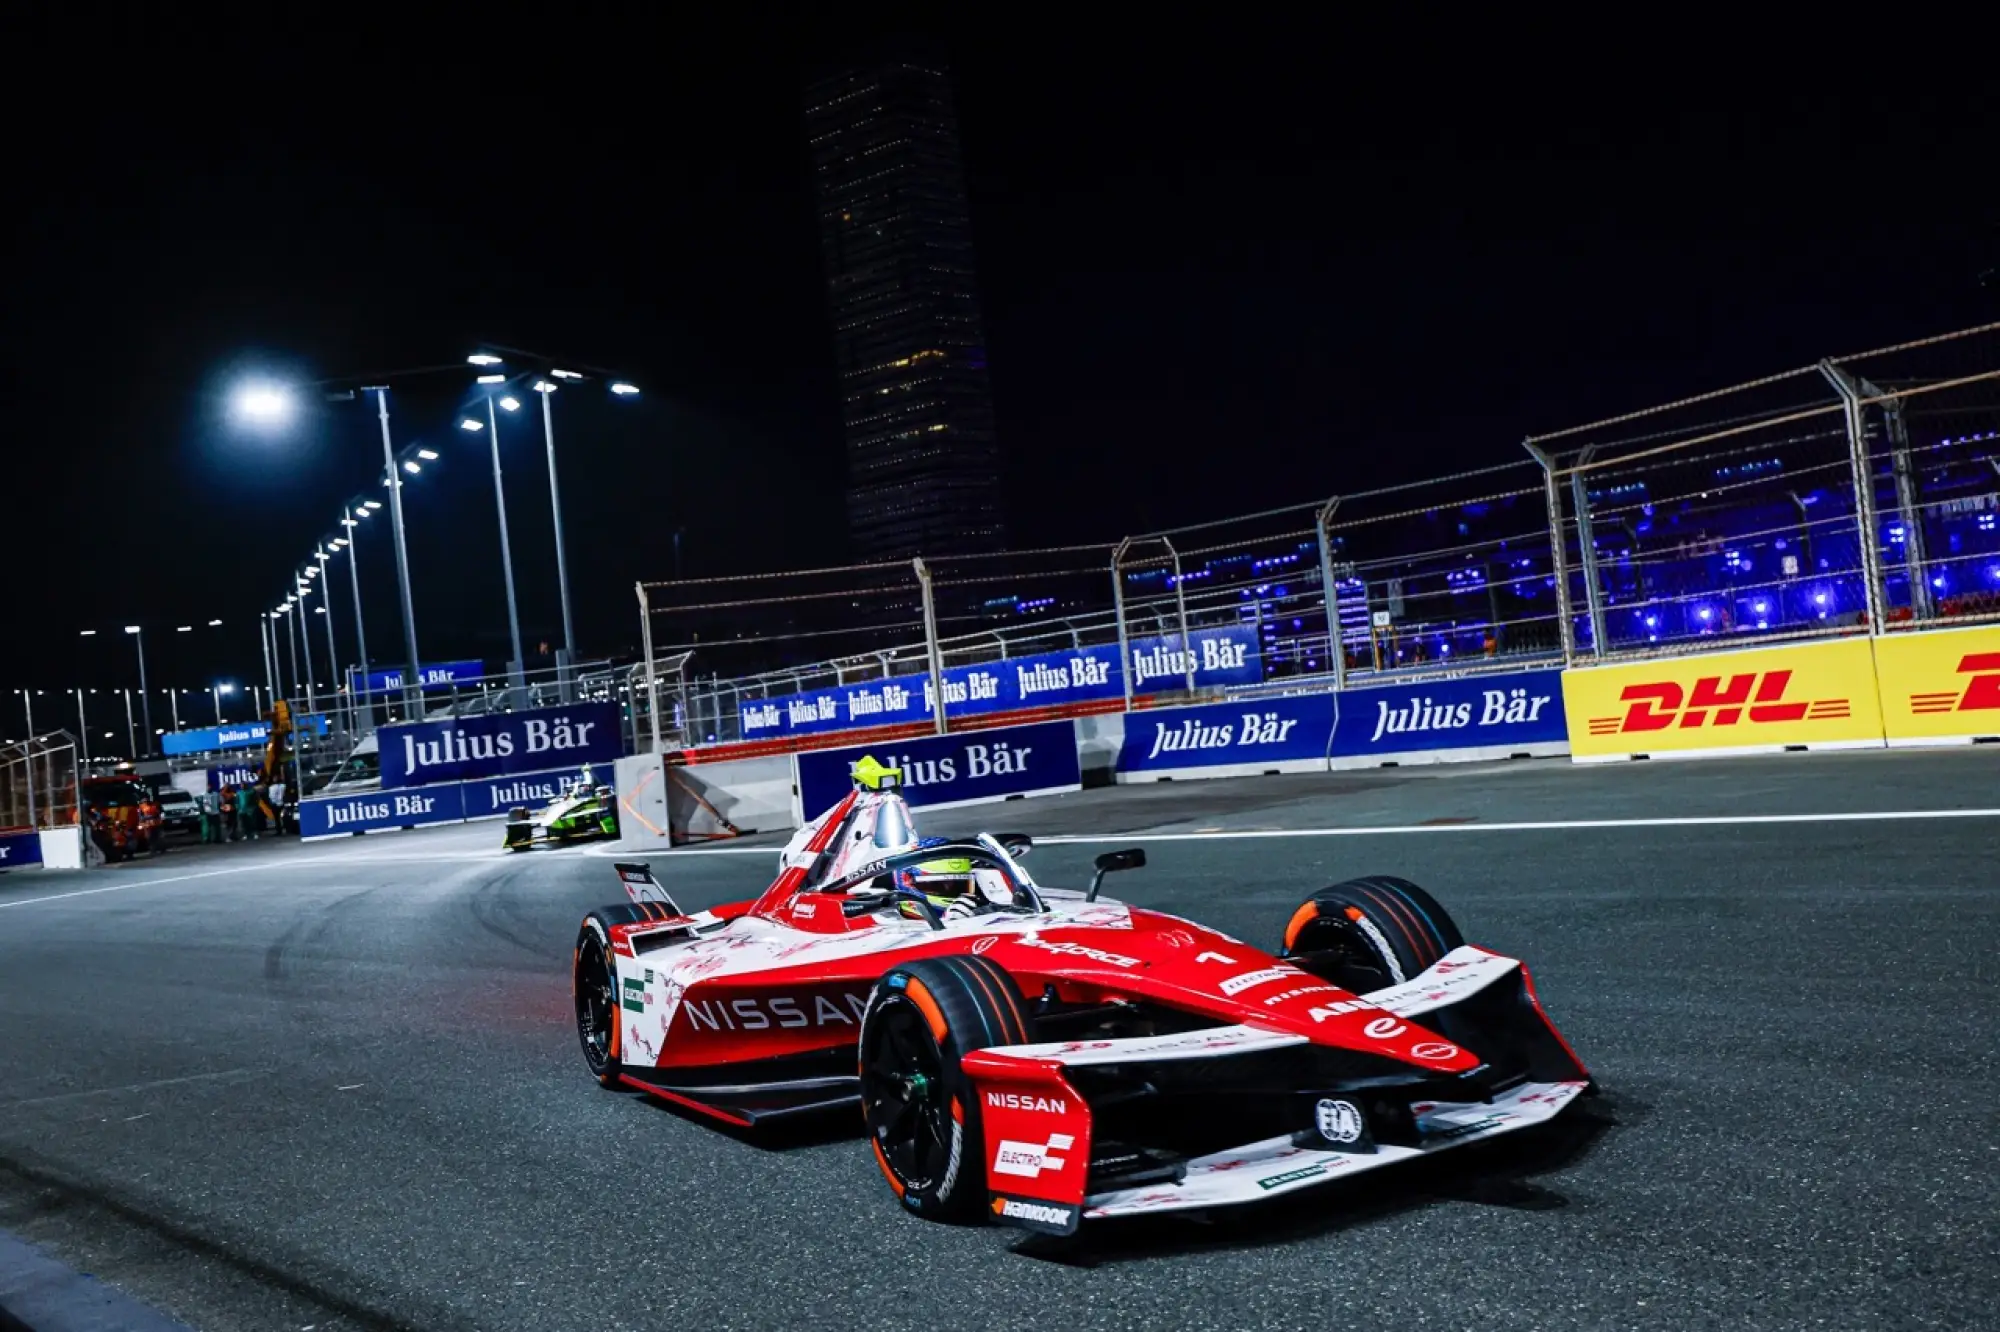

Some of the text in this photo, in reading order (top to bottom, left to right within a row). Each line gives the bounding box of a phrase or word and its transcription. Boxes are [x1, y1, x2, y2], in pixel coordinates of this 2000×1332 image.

[1017, 656, 1110, 700] Julius Bär
[1133, 638, 1247, 686] Julius Bär
[848, 685, 910, 721] Julius Bär
[924, 672, 999, 712] Juius Bär
[1619, 670, 1808, 732] DHL
[789, 696, 836, 728] Julius Bär
[1370, 688, 1550, 742] Julius Bär
[218, 731, 249, 745] Julius
[403, 717, 595, 775] Julius Bär
[1148, 712, 1297, 759] Julius Bär
[964, 742, 1032, 779] Bär
[326, 794, 435, 828] Julius Bär
[490, 782, 554, 809] Julius
[987, 1092, 1066, 1114] NISSAN
[1001, 1150, 1042, 1166] ELECTRO
